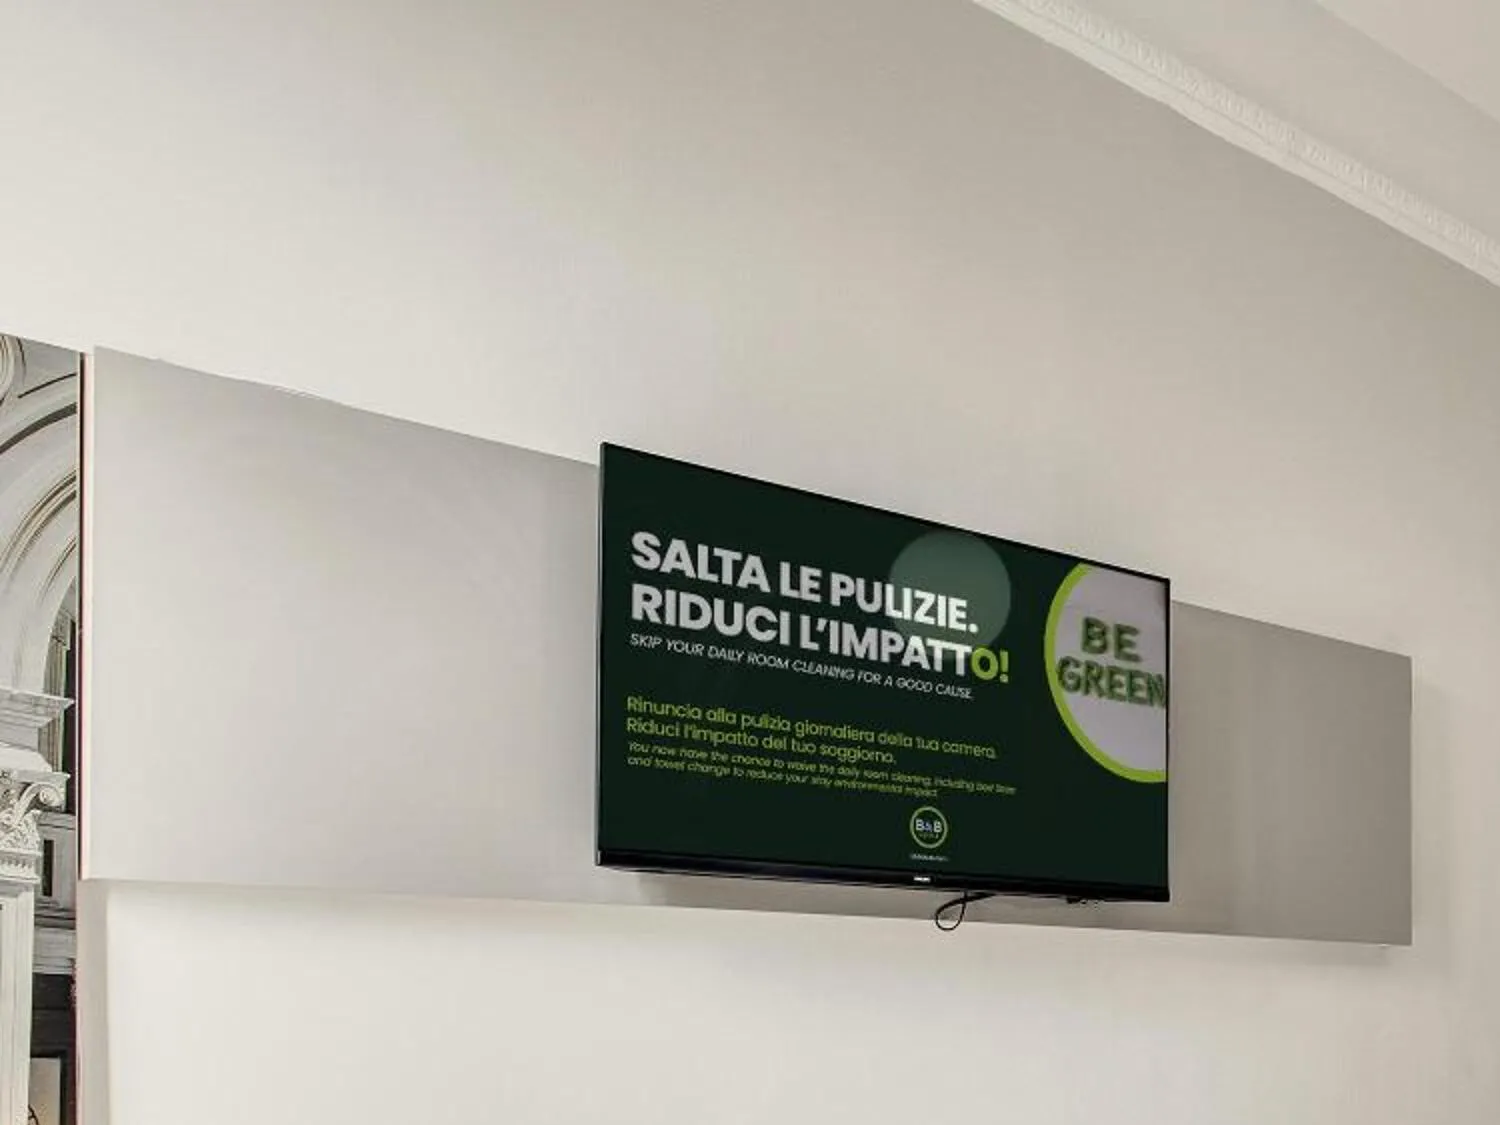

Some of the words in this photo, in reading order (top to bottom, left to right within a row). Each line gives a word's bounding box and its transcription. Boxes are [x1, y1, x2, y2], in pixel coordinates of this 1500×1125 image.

[631, 531, 771, 593] SALTA
[779, 561, 822, 603] LE
[830, 571, 979, 633] PULIZIE.
[631, 583, 791, 646] RIDUCI
[1081, 616, 1143, 663] BE
[629, 633, 663, 649] SKIP
[666, 639, 705, 656] YOUR
[707, 645, 745, 663] DAILY
[747, 652, 790, 670] ROOM
[791, 659, 855, 680] CLEANING
[857, 671, 883, 686] FOR
[883, 675, 894, 688] A
[895, 676, 933, 693] GOOD
[1057, 656, 1166, 709] GREEN
[626, 696, 702, 720] Rinuncia
[705, 707, 737, 724] alla
[741, 714, 791, 732] pulizia
[795, 720, 875, 743] giornaliera
[877, 731, 913, 748] della
[915, 736, 939, 751] tua
[626, 717, 680, 737] Riduci
[761, 735, 787, 750] del
[792, 738, 817, 754] tuo
[819, 744, 897, 764] soggiorno.
[628, 741, 650, 753] You
[628, 755, 653, 766] and
[915, 818, 943, 833] B&B
